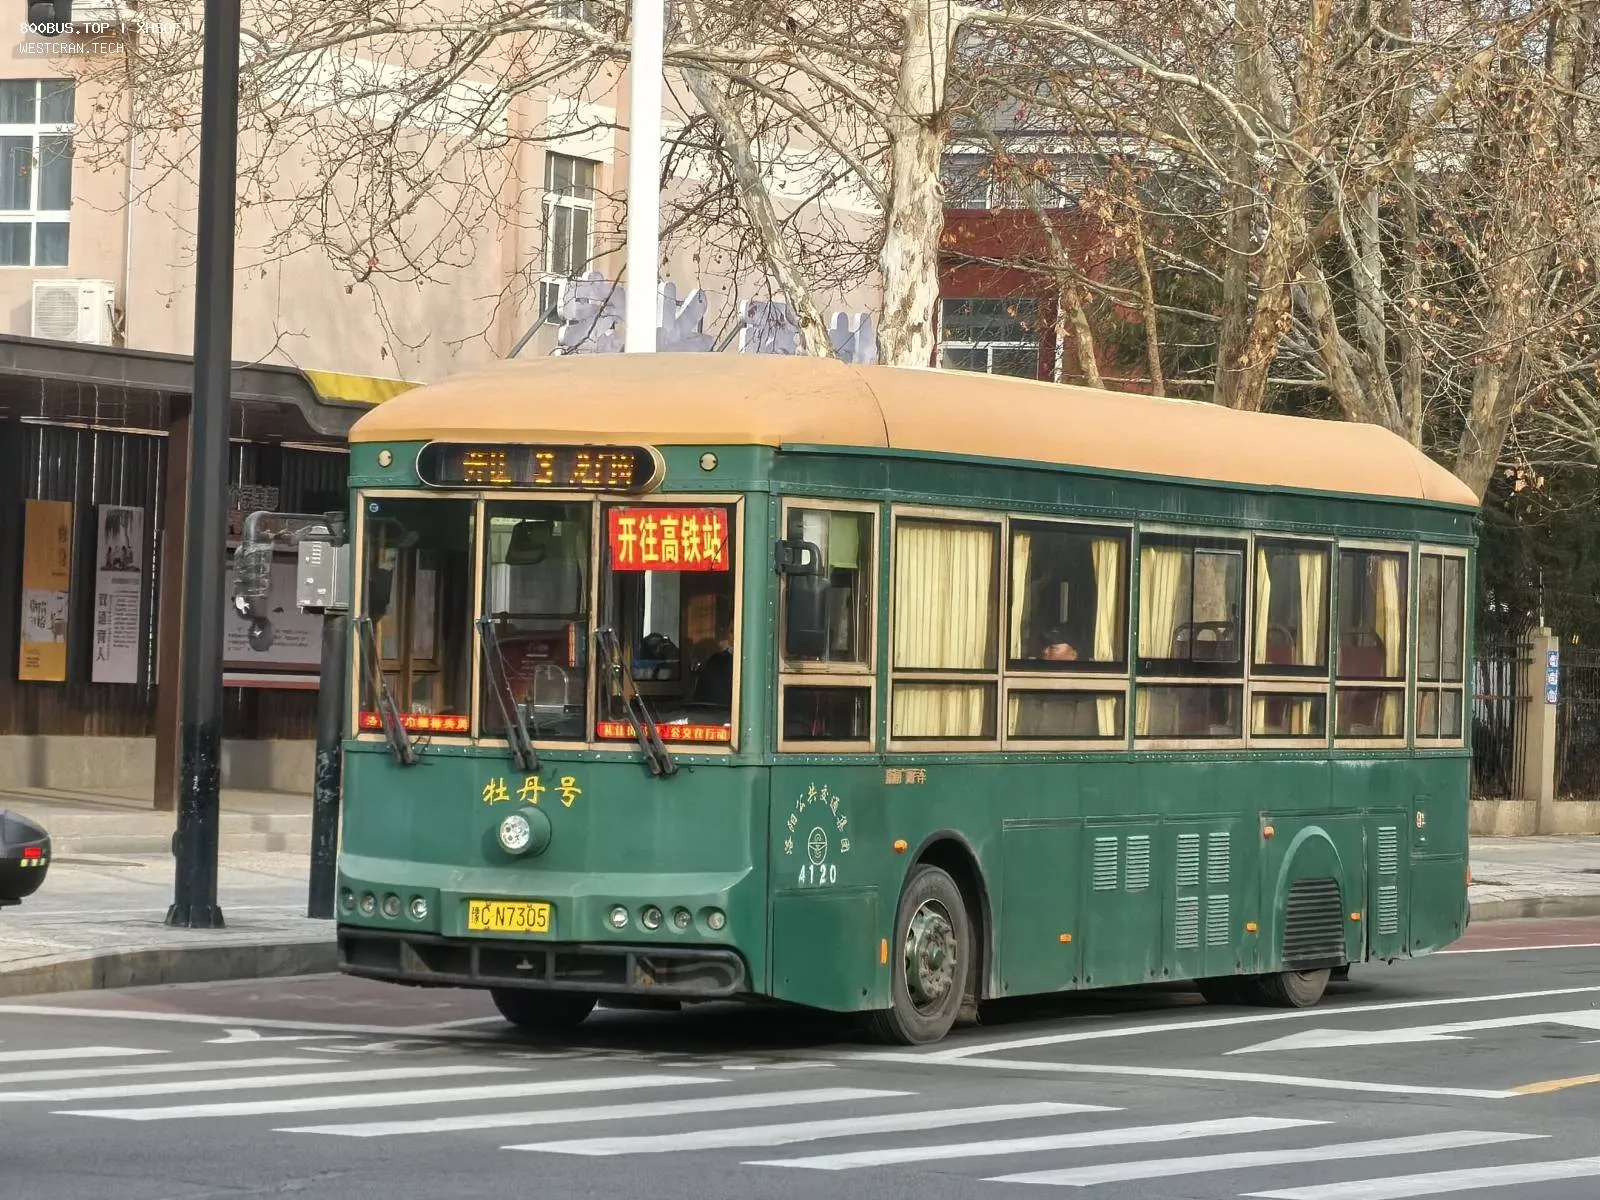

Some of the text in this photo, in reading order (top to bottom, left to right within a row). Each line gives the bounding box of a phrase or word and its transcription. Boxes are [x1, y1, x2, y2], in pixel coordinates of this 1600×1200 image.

[617, 513, 722, 564] 开往高铁站
[482, 775, 582, 808] 牡丹号
[798, 863, 837, 885] 4120
